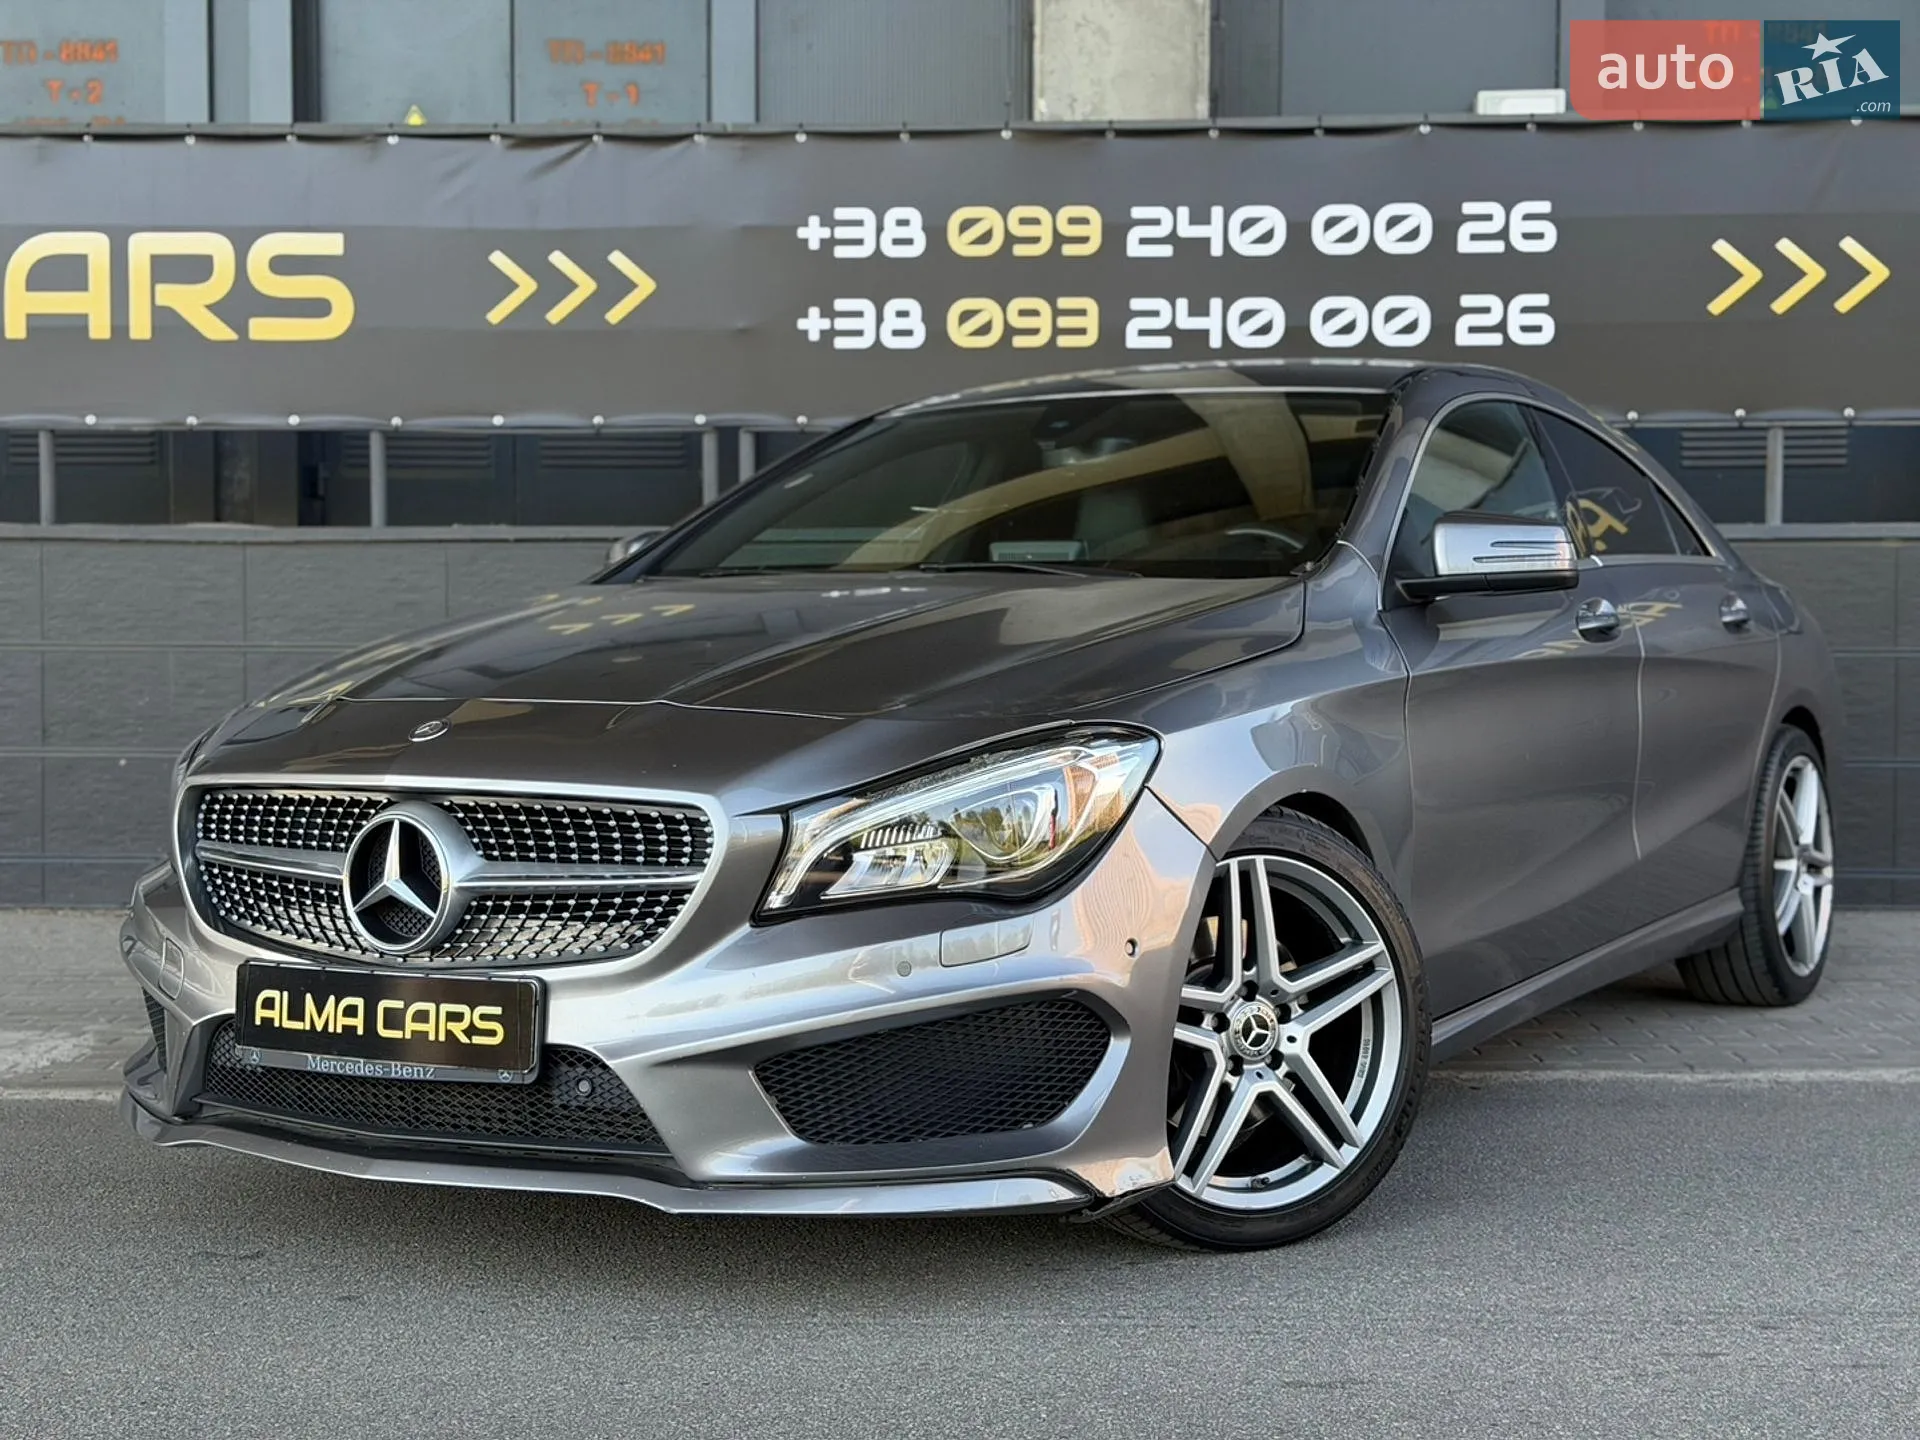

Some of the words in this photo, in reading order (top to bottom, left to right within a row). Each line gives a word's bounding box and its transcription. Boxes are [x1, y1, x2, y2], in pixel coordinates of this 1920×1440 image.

[797, 206, 926, 259] +38
[947, 205, 1103, 257] 099
[1126, 204, 1287, 258] 240
[1310, 202, 1433, 256] 00
[1456, 200, 1558, 254] 26
[3, 231, 356, 342] ARS
[797, 297, 926, 350] +38
[946, 296, 1102, 349] 093
[1124, 296, 1286, 349] 240
[1309, 295, 1432, 348] 00
[1454, 293, 1556, 346] 26
[254, 989, 365, 1036] ALMA
[376, 999, 505, 1046] CARS
[306, 1054, 436, 1079] Mercedes-Benz
